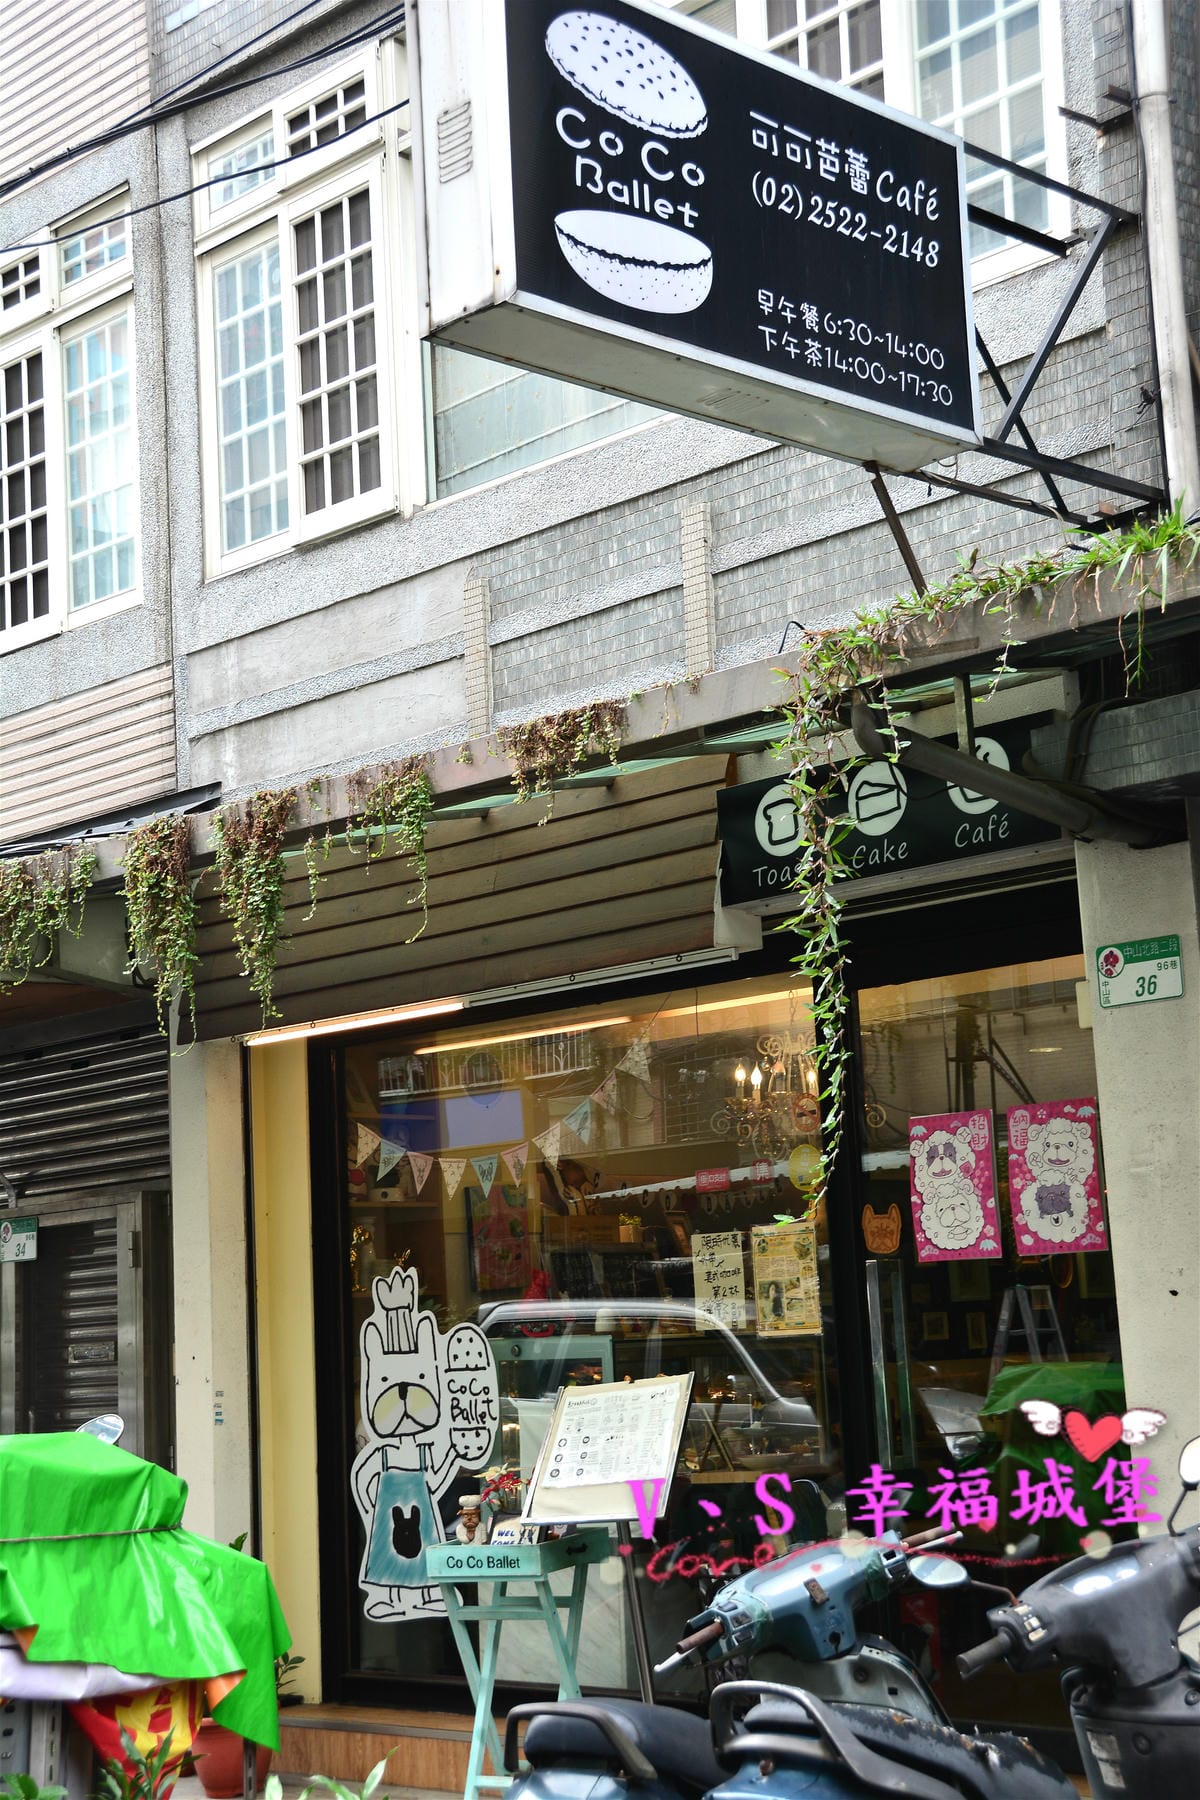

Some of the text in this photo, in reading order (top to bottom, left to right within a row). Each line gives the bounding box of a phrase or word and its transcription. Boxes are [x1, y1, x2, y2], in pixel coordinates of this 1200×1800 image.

[750, 111, 939, 221] 可可芭蕾 Café
[575, 154, 699, 228] Ballet
[752, 170, 939, 268] (02) 2522-2148
[955, 813, 1010, 848] Café
[852, 838, 909, 869] Cake
[1123, 938, 1178, 958] 中山北路二段
[1135, 974, 1157, 997] 36
[15, 1242, 26, 1257] 34
[450, 1397, 497, 1424] Ballet
[497, 1530, 515, 1538] WEL
[446, 1555, 520, 1569] Co Co Ballet
